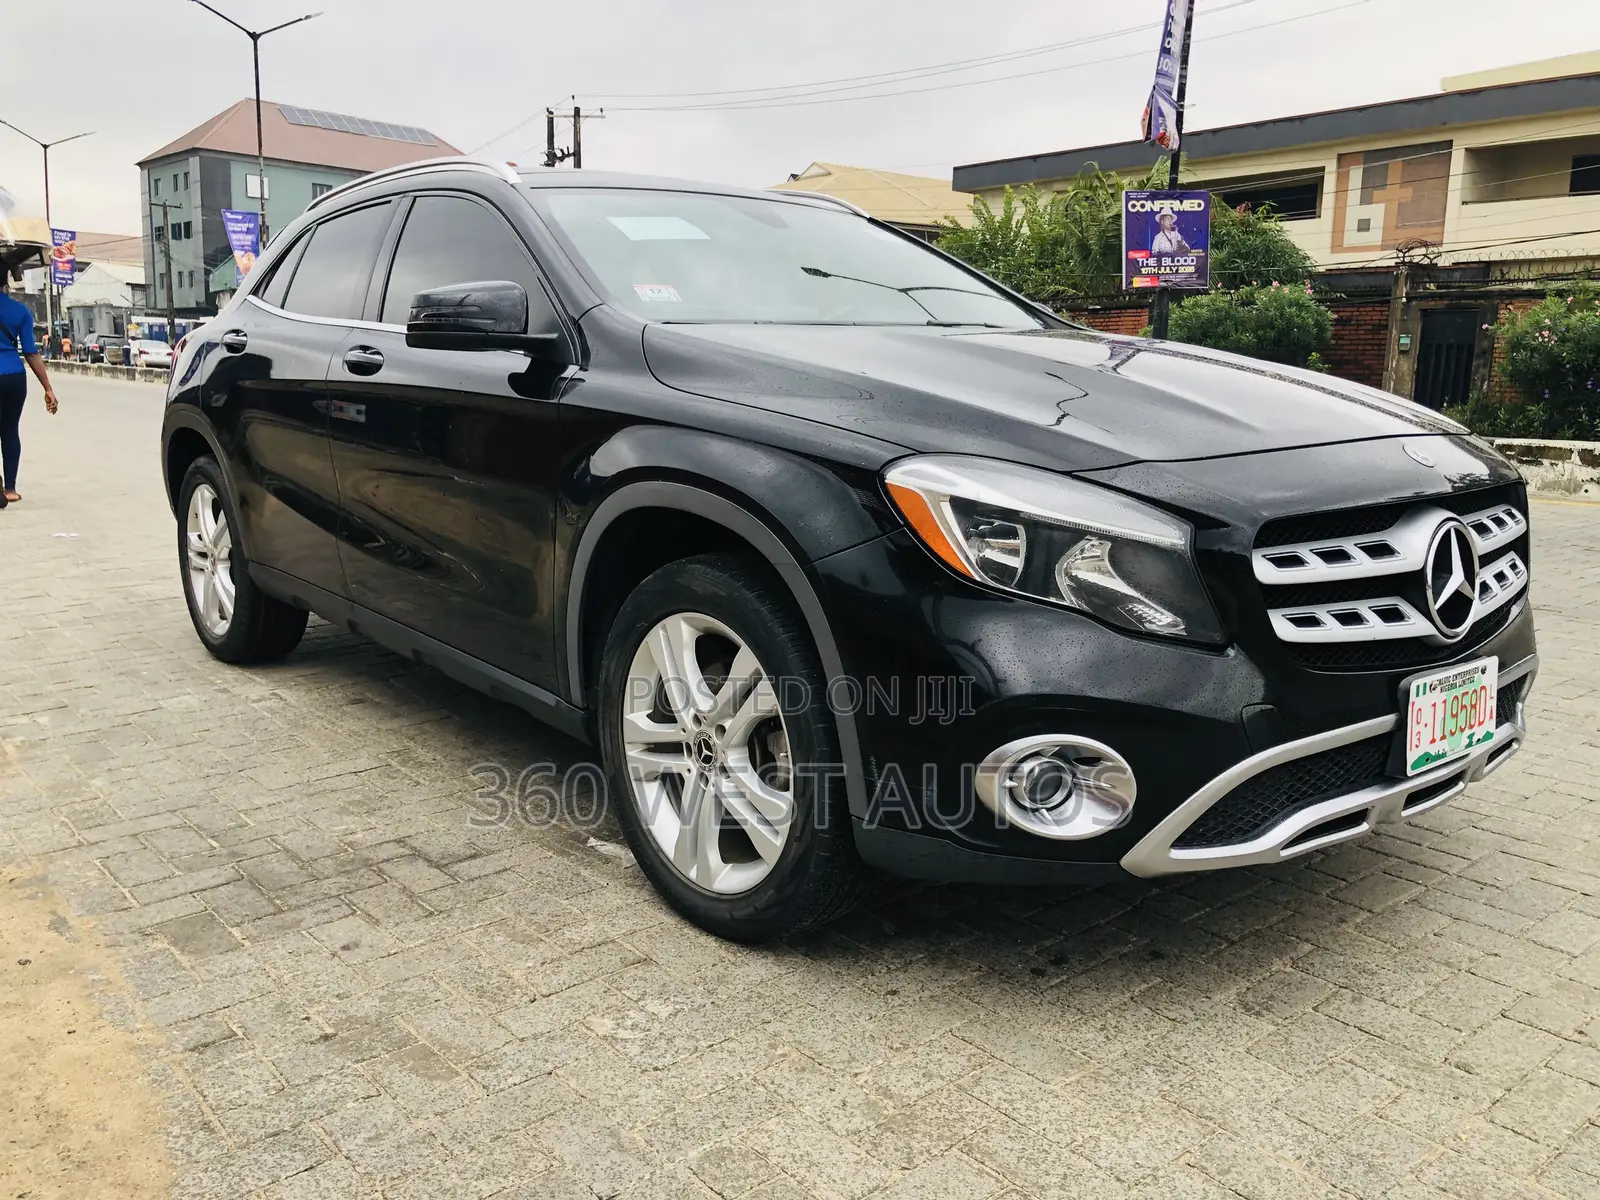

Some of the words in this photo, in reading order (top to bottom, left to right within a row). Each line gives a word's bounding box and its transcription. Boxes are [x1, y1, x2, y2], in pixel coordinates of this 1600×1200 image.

[1128, 200, 1204, 212] CONFIRMED
[1137, 258, 1158, 266] THE
[1161, 257, 1197, 266] BLOOD
[1158, 266, 1177, 274] JULY
